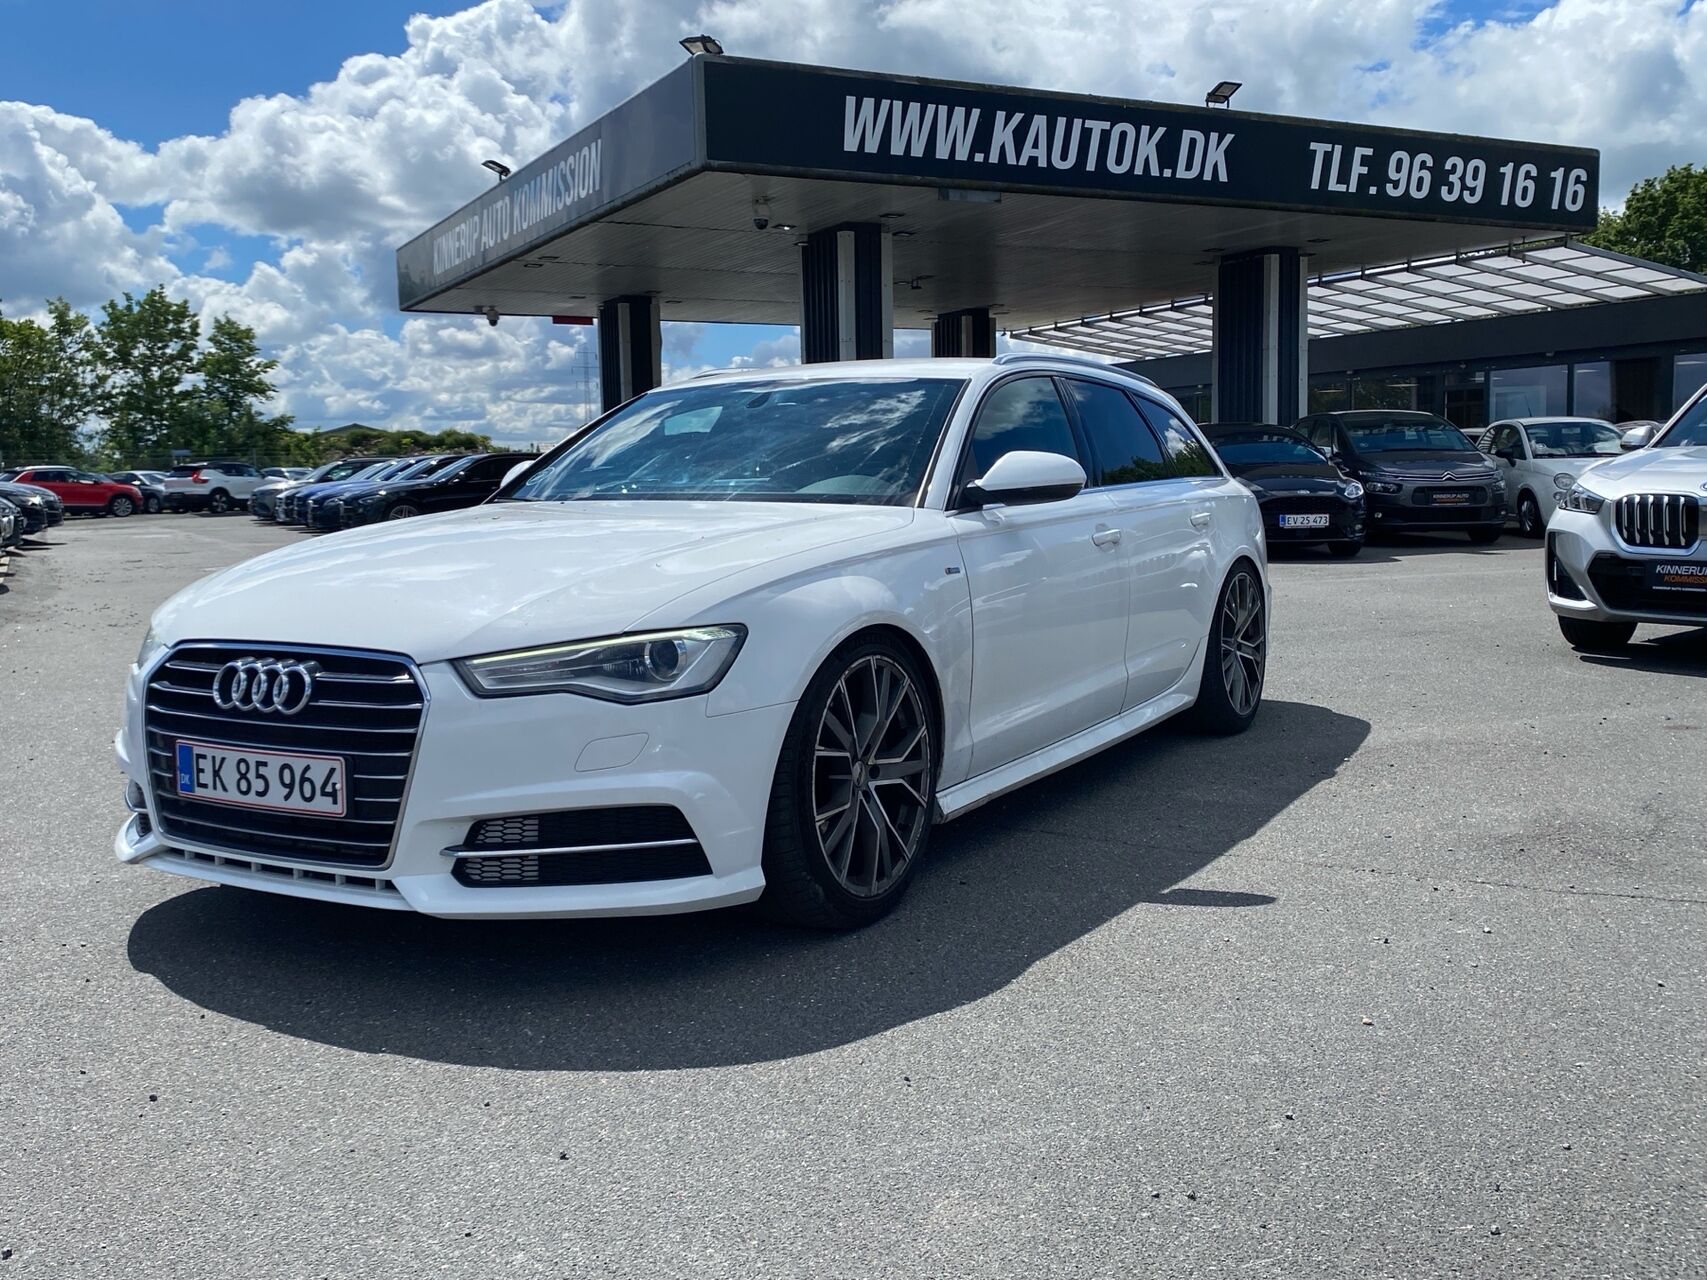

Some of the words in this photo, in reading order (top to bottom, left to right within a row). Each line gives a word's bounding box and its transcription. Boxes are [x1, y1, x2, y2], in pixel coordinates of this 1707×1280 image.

[843, 95, 1236, 183] WWW.KAUTOK.DK
[432, 214, 480, 275] KINNERUP
[480, 195, 511, 252] AUTO
[513, 138, 602, 235] KOMMISSION
[1309, 141, 1378, 195] TLF.
[1385, 150, 1434, 200] 96
[1440, 156, 1487, 204] 39
[1499, 161, 1538, 208] 16
[1549, 166, 1588, 212] 16
[1286, 516, 1298, 525] EV
[1300, 516, 1310, 525] 25
[1312, 515, 1328, 525] 473
[181, 773, 191, 785] DK
[195, 753, 229, 793] EK
[236, 757, 270, 798] 85
[278, 763, 339, 805] 964
